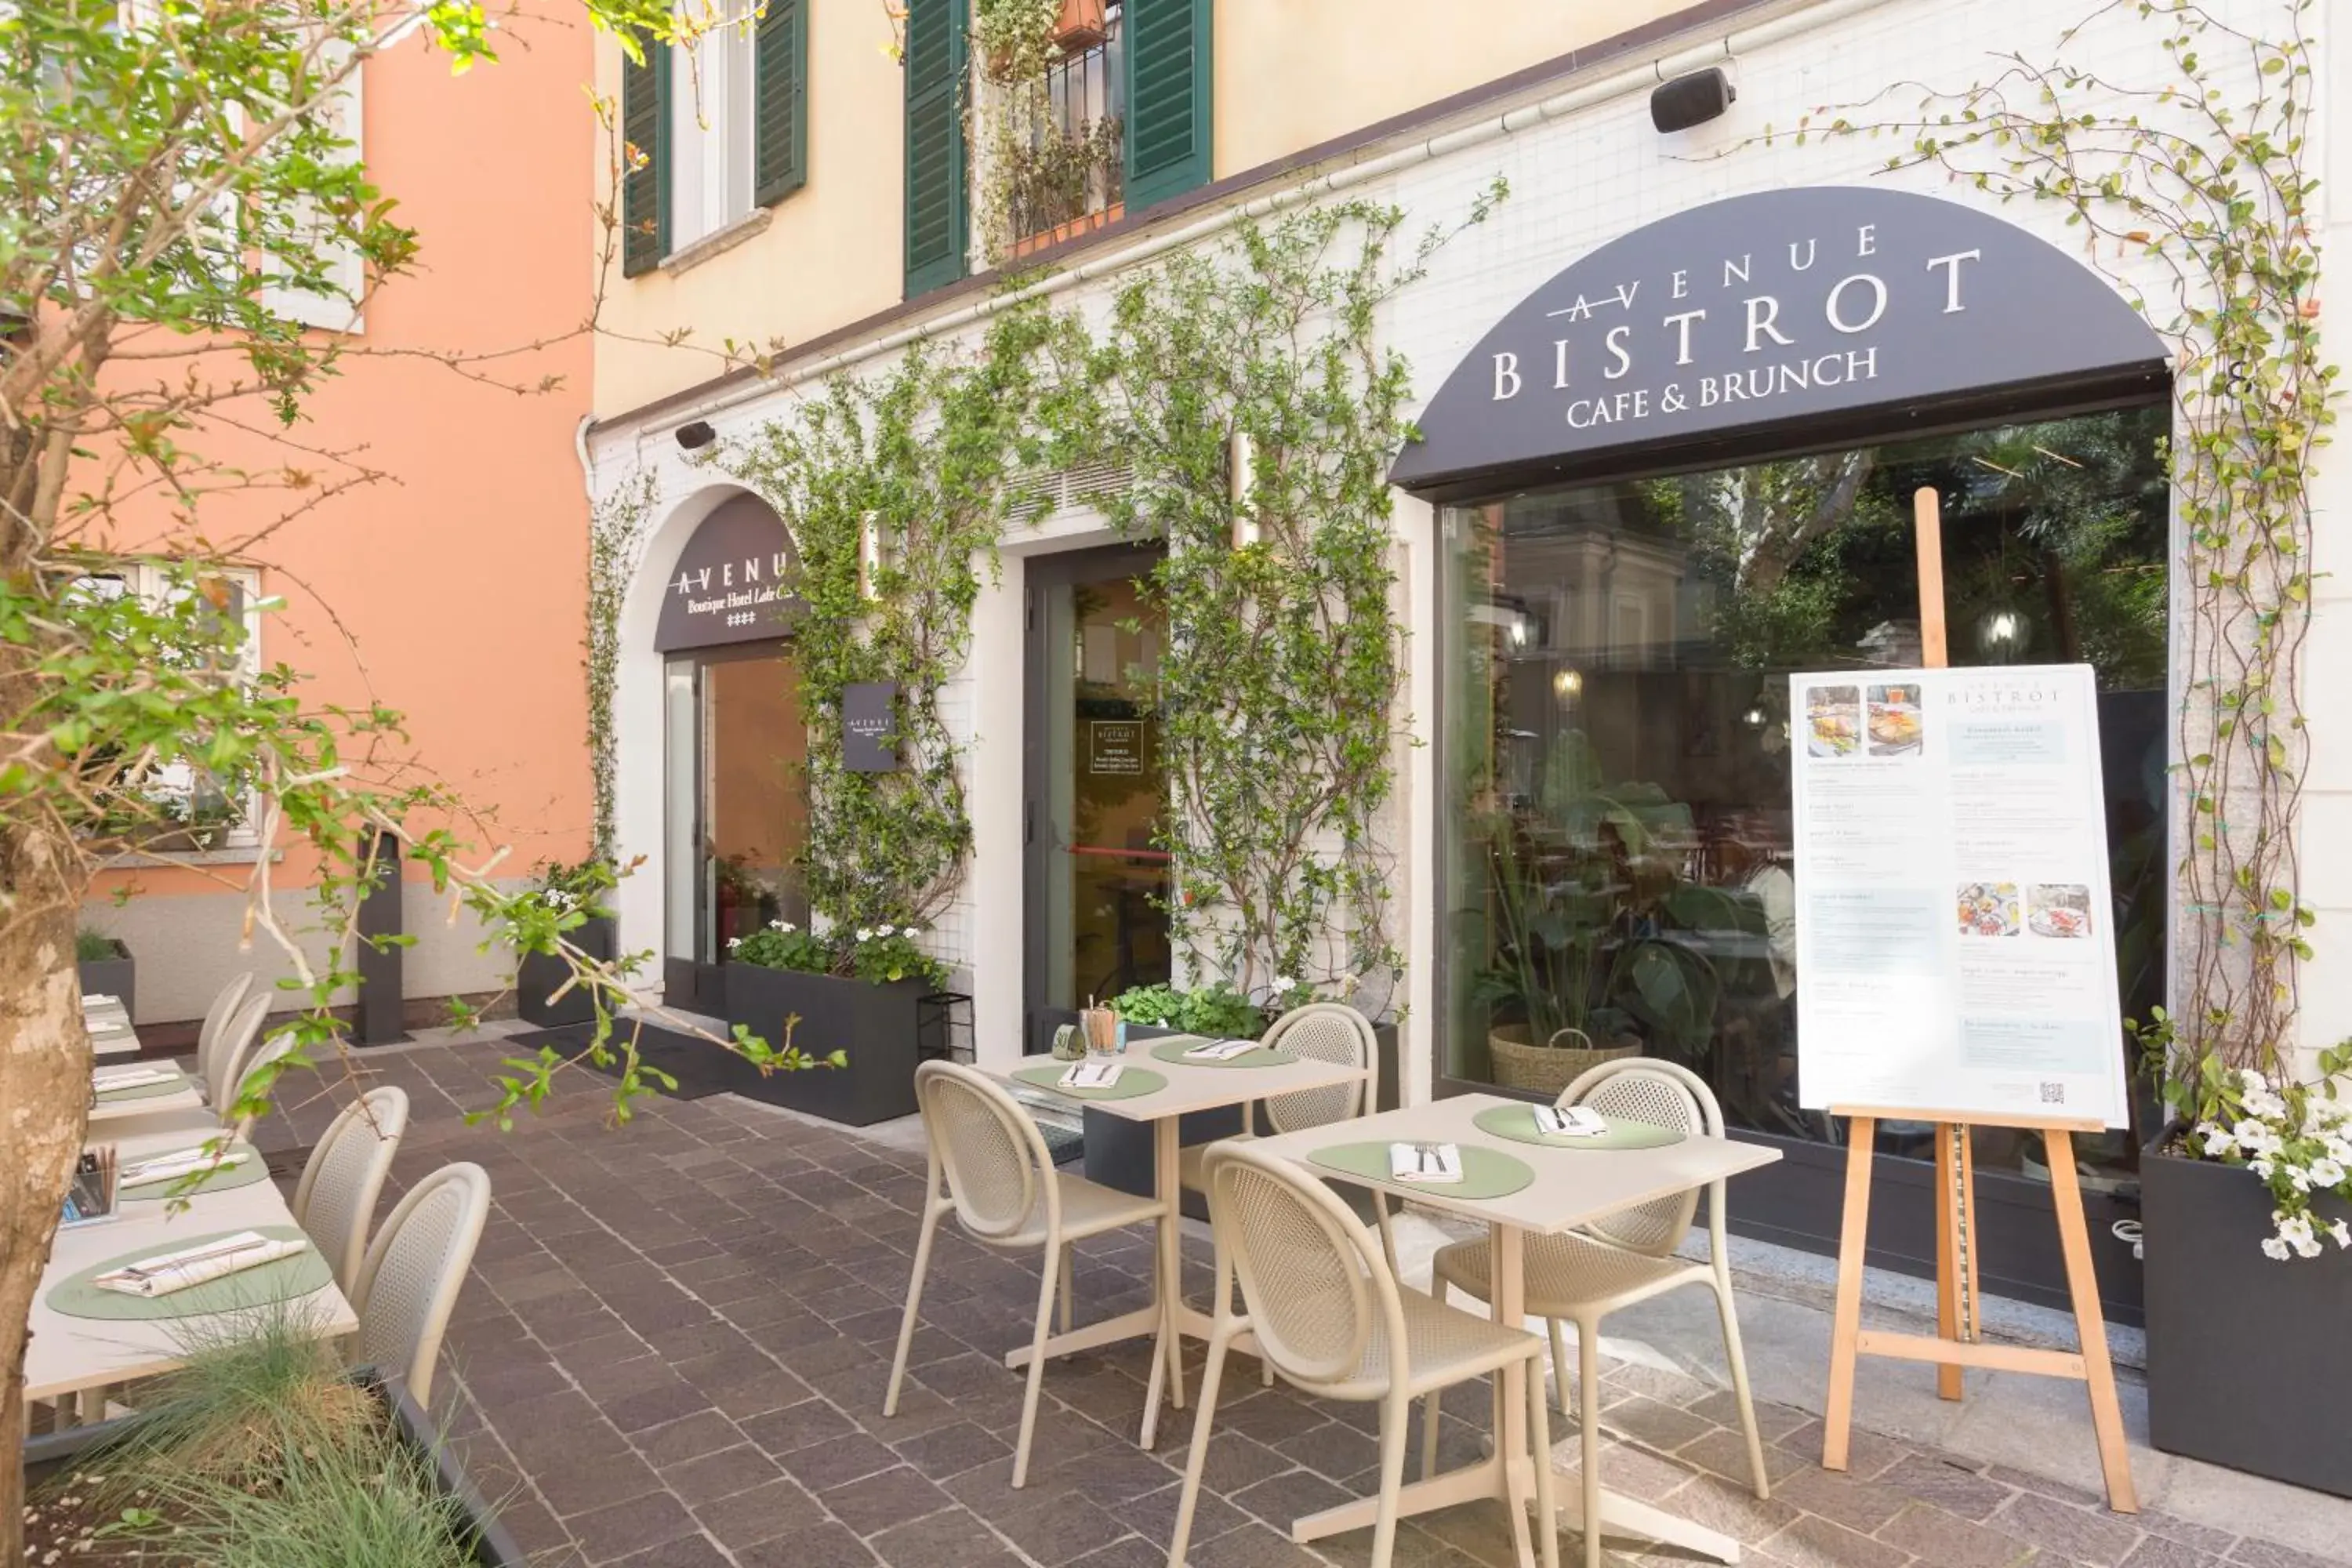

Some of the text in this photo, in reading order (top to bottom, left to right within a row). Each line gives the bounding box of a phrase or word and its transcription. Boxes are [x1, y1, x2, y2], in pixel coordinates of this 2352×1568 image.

[1546, 223, 1876, 322] AVENUE
[1492, 248, 1981, 401] BISTROT
[1566, 347, 1878, 429] CAFE & BRUNCH
[669, 552, 787, 594] AVENU
[688, 596, 726, 615] Boutique
[728, 589, 753, 608] Hotel
[1947, 689, 2062, 705] BISTROT
